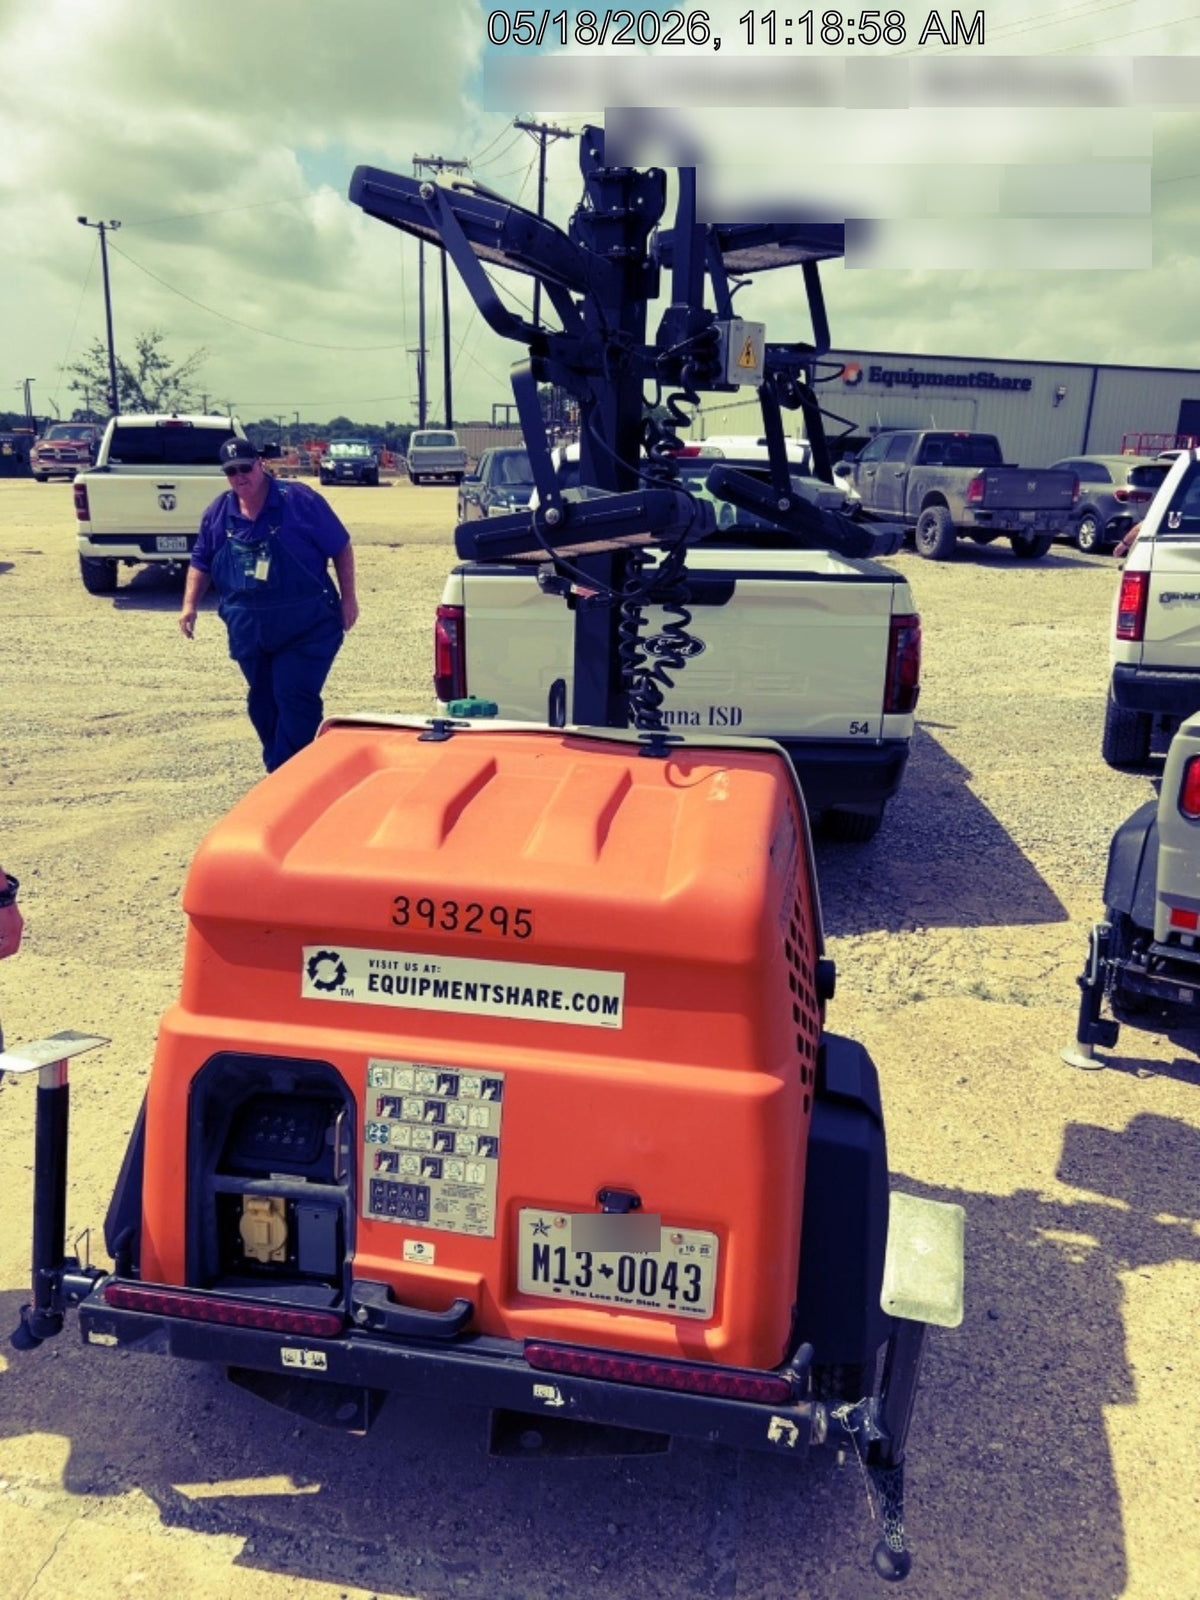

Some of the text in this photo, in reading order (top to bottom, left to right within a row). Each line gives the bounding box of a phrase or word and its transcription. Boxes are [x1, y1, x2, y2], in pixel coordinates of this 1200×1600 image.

[867, 365, 1033, 392] EquipmentShare
[663, 705, 743, 727] nna ISD
[849, 721, 870, 735] 54
[391, 895, 533, 940] 393295
[368, 958, 442, 974] VISIT US AT:
[340, 987, 355, 998] TM
[367, 973, 620, 1016] EQUIPMENTSHARE.COM
[532, 1242, 702, 1303] M13 0043
[570, 1289, 661, 1308] The Lone Star State
